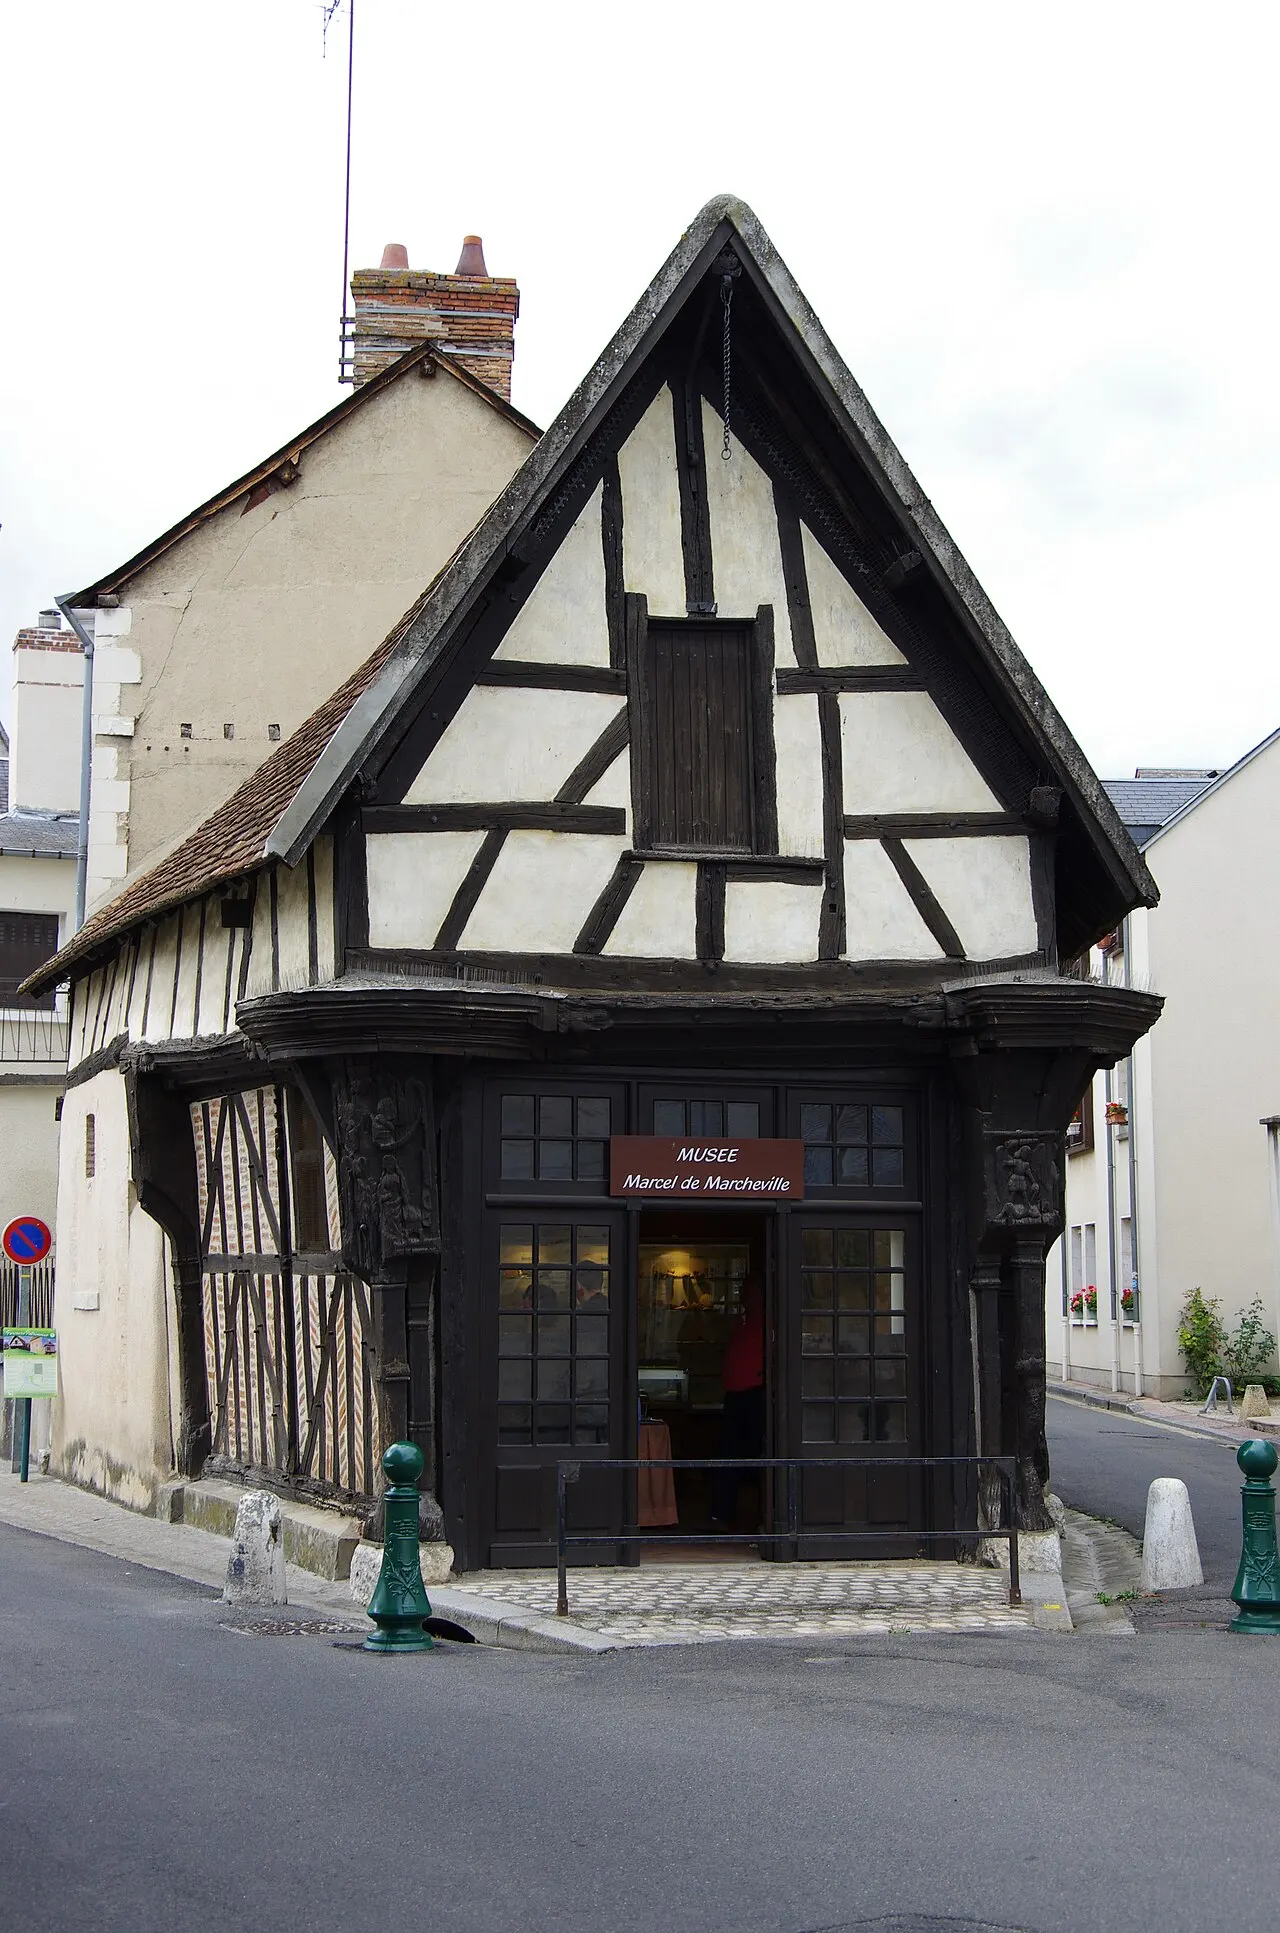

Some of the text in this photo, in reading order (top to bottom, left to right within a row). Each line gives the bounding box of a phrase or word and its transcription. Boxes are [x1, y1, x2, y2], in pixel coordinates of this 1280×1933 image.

[676, 1148, 739, 1162] MUSEE
[623, 1174, 791, 1192] Marcel de Marcheville
